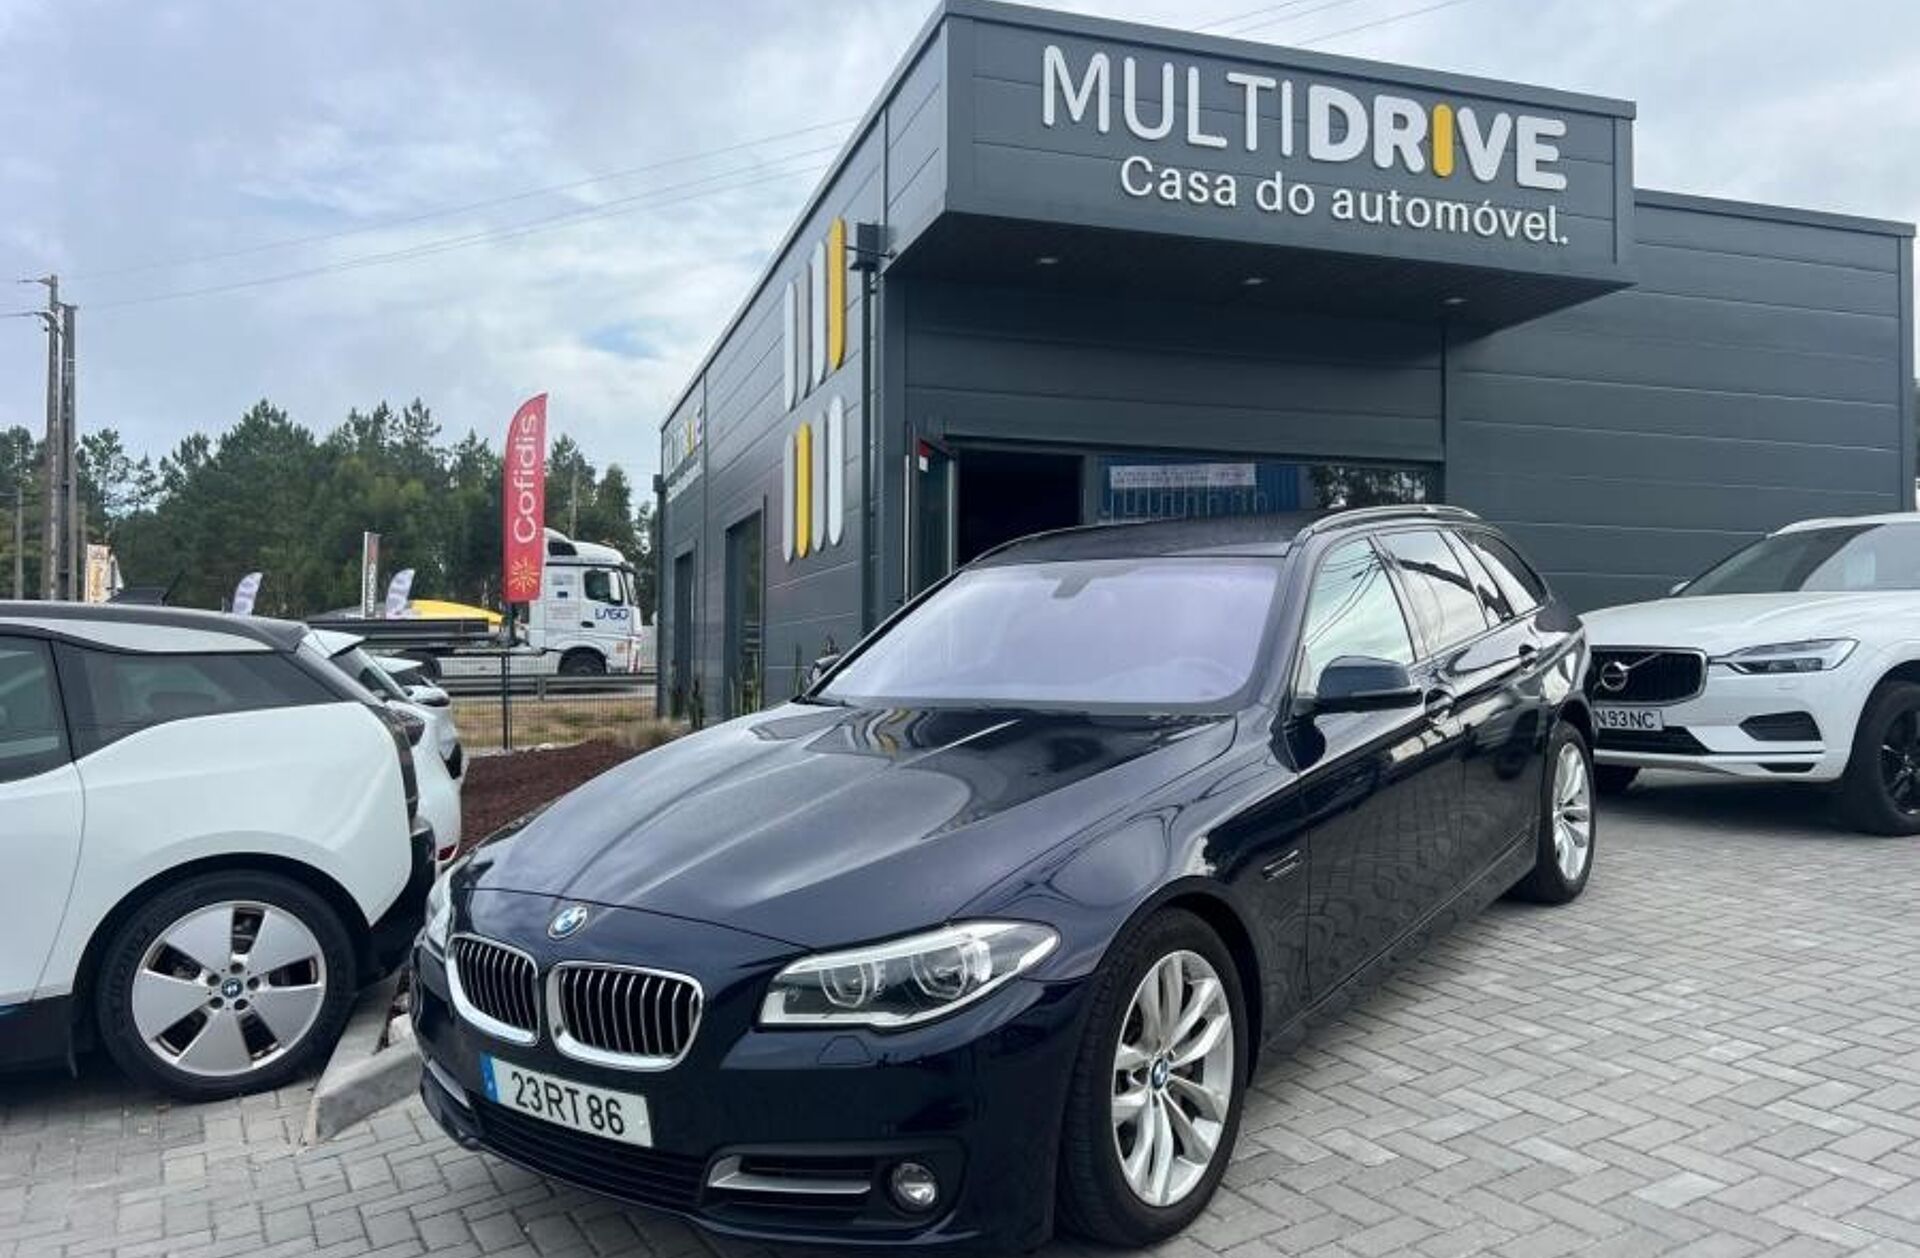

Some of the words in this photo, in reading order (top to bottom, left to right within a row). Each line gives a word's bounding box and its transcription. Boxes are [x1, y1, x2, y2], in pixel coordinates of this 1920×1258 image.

[1043, 45, 1568, 190] MULTIDRIVE
[1121, 156, 1237, 207] Casa
[1256, 171, 1315, 215] do
[1331, 188, 1569, 245] automóvel.
[513, 413, 536, 544] Cofidis
